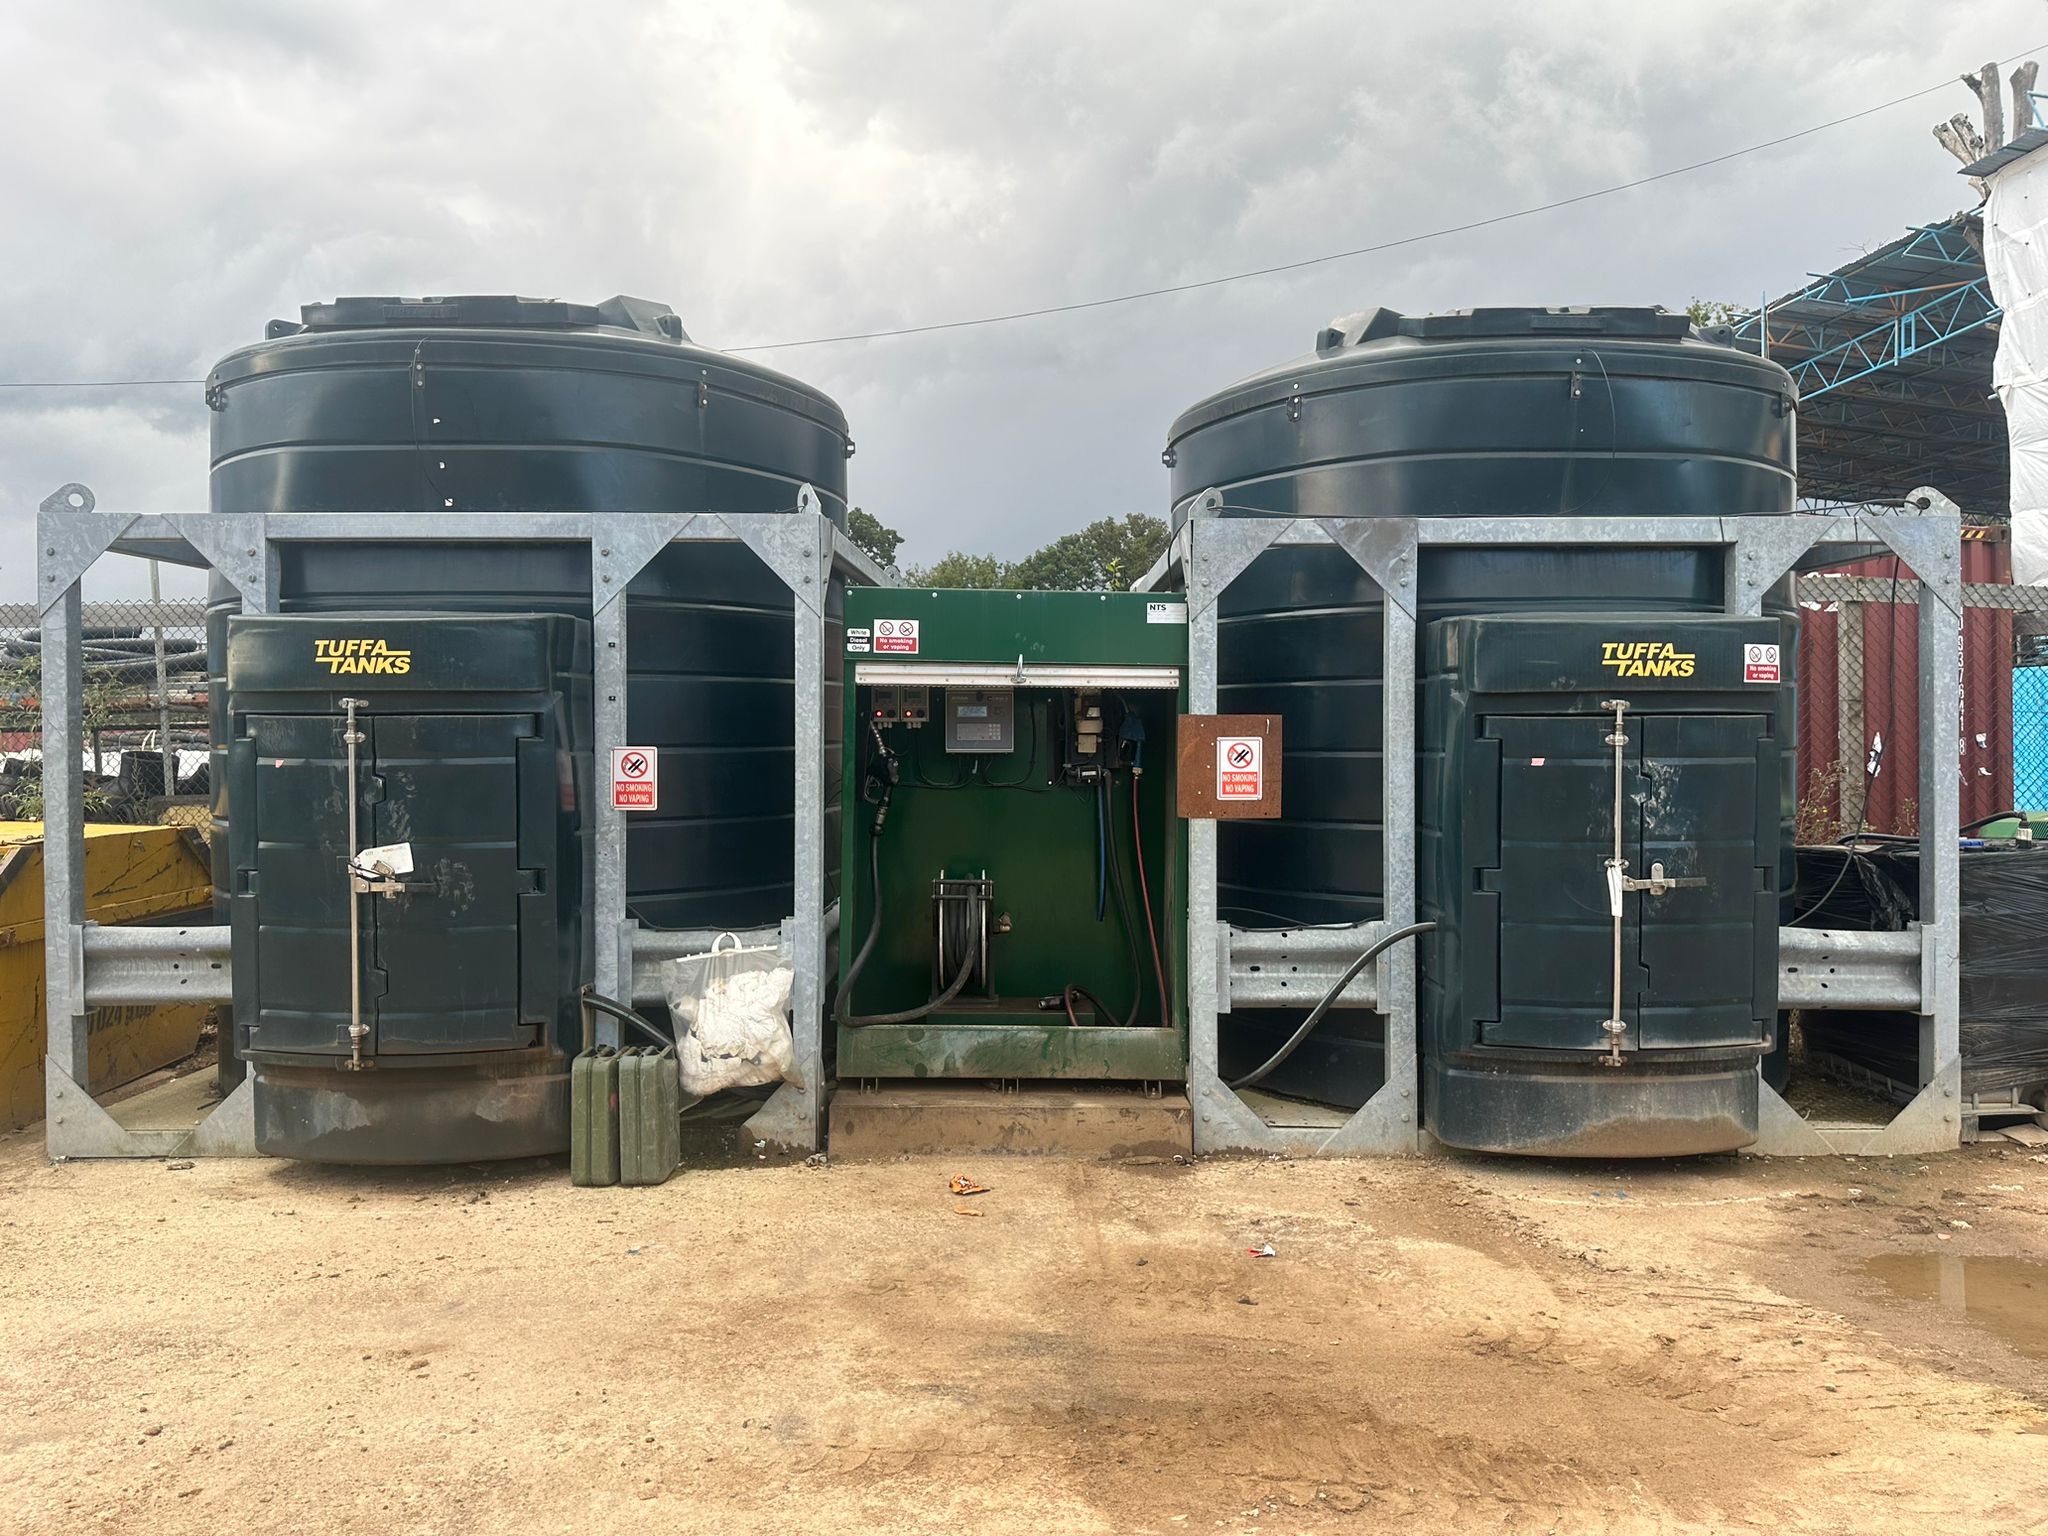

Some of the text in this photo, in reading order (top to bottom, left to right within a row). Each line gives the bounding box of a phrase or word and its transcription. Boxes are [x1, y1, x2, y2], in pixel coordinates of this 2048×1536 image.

[314, 639, 411, 656] TUFFA
[1601, 642, 1696, 660] TUFFA
[314, 656, 411, 674] TANKS
[1602, 659, 1696, 677] TANKS
[1222, 774, 1256, 782] NO SMOKING
[616, 784, 652, 792] NO SMOKING
[619, 795, 650, 803] NO VAPING
